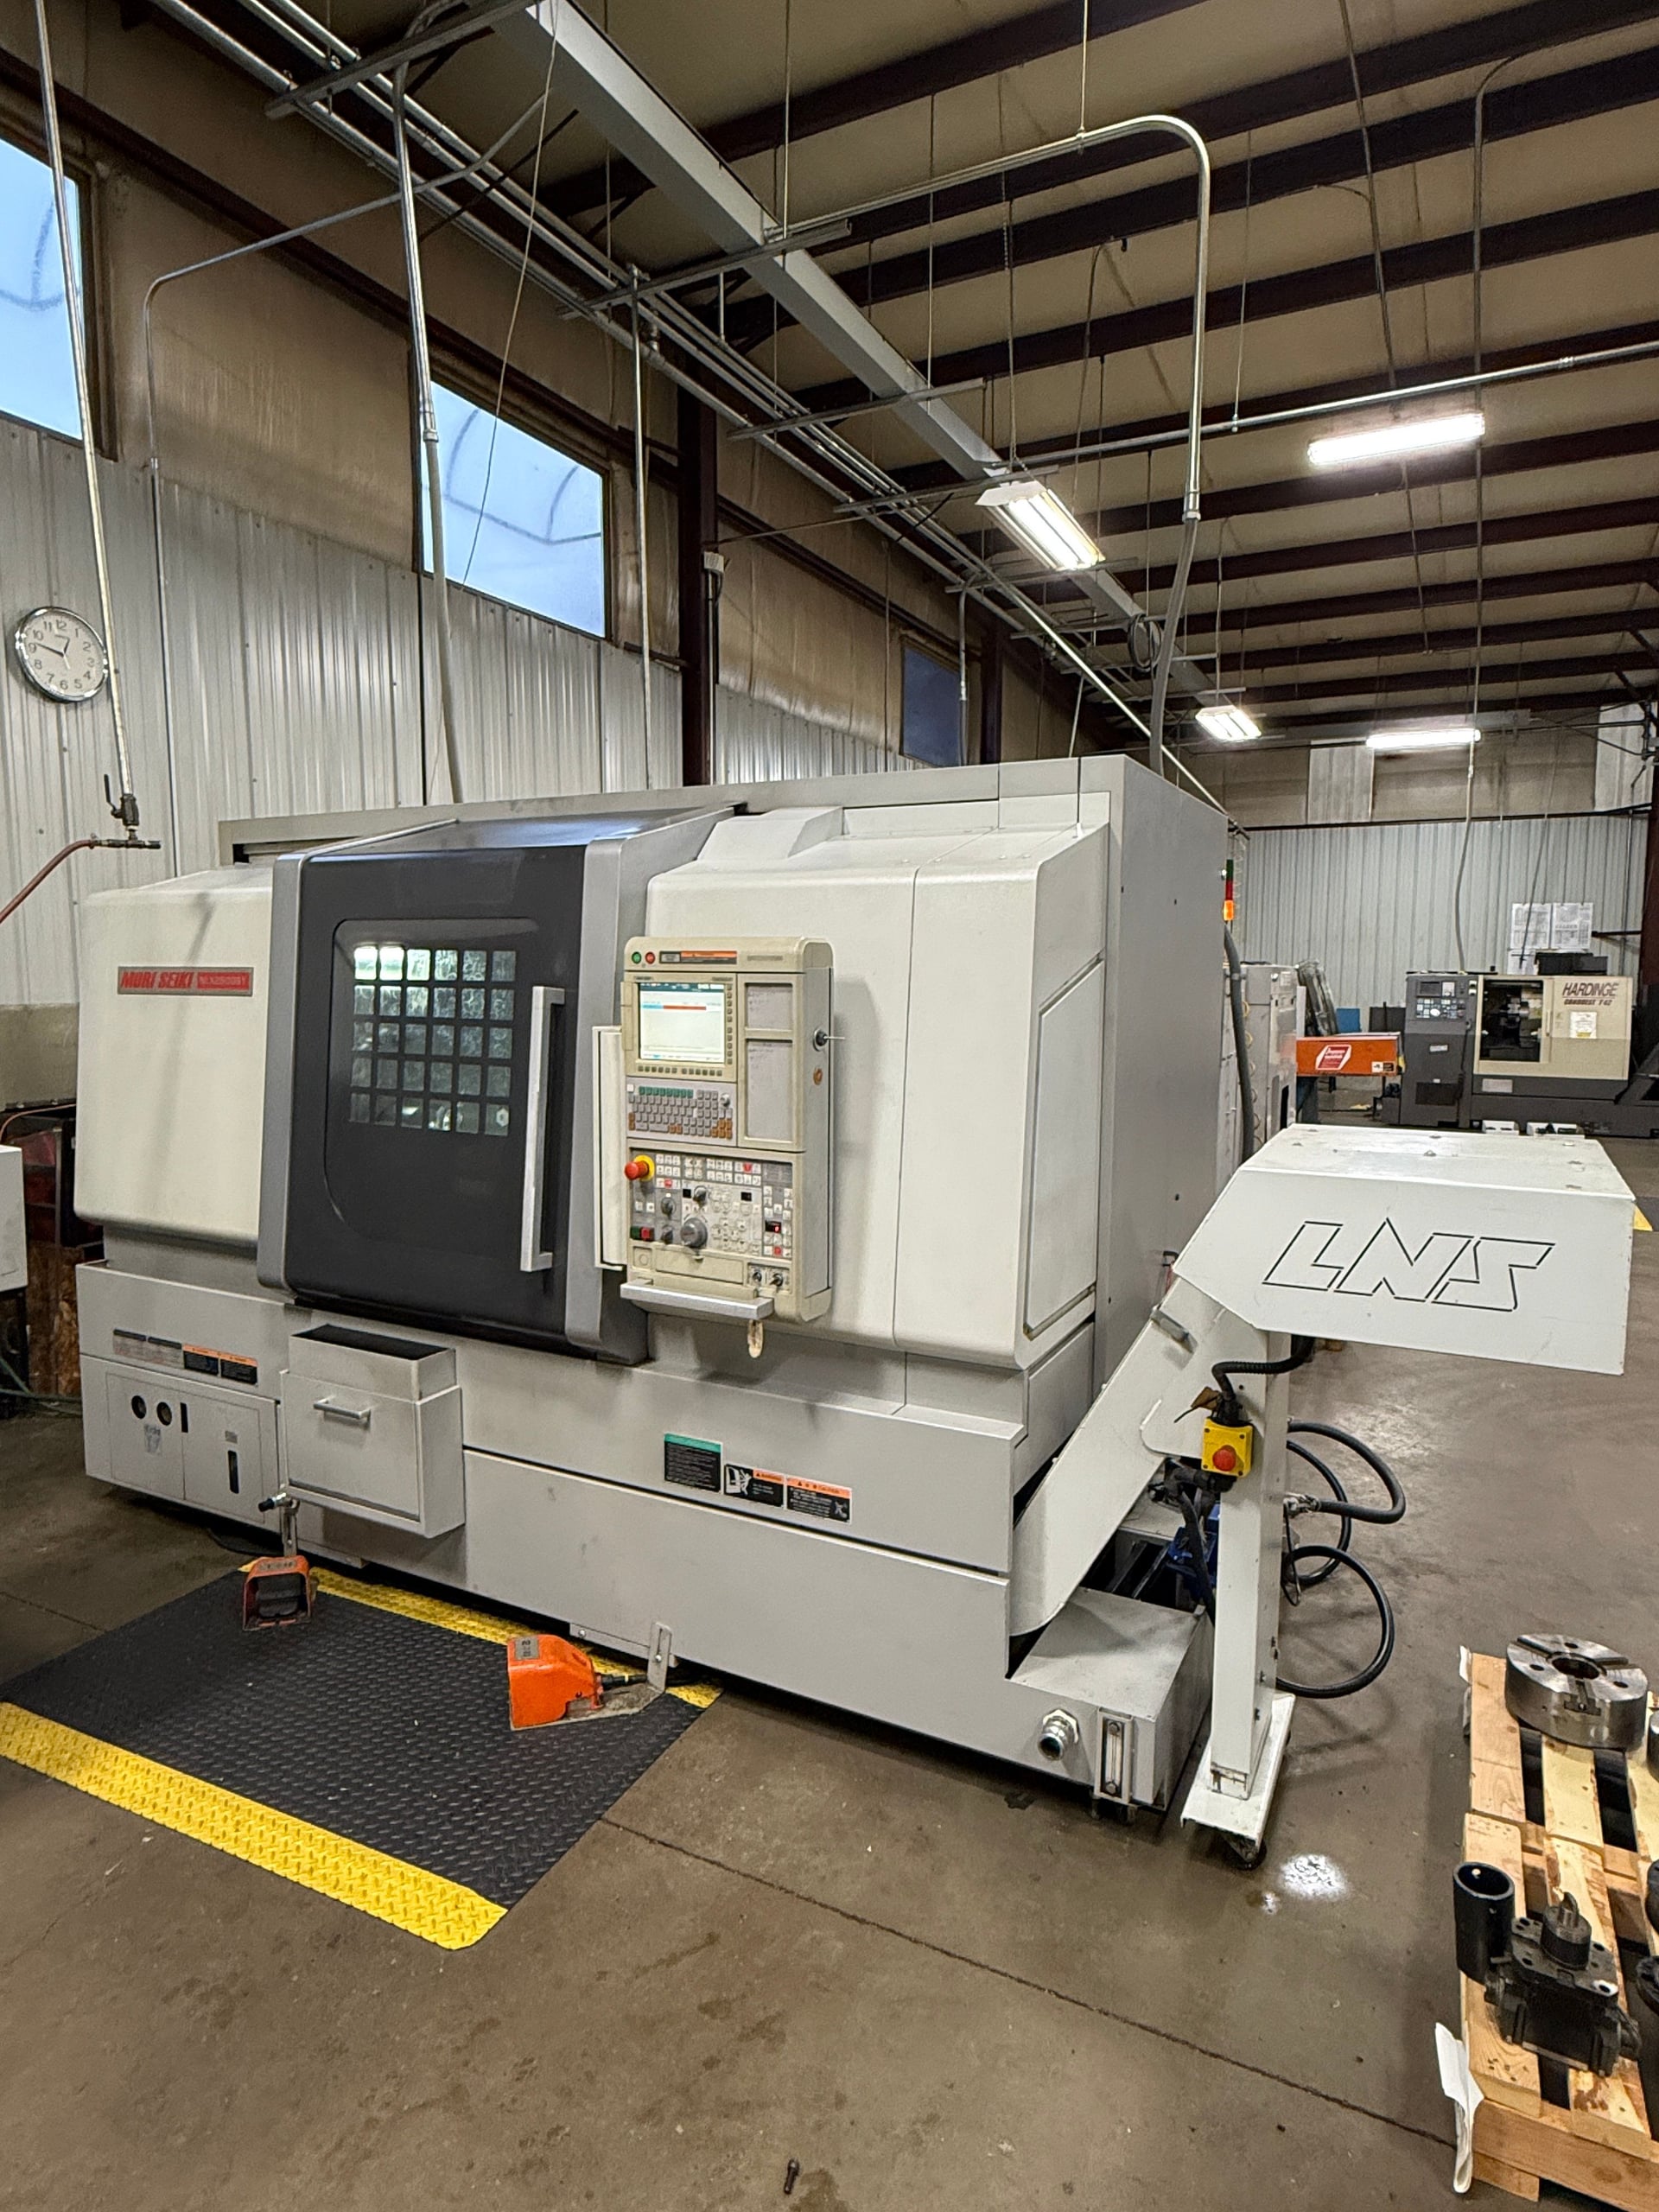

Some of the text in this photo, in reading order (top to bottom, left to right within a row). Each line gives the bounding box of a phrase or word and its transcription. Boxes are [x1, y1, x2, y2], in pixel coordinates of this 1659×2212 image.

[44, 620, 52, 632] 11
[55, 620, 67, 630] 12
[33, 630, 44, 640] 10
[74, 628, 79, 638] 1
[29, 643, 37, 653] 9
[82, 641, 92, 652] 2
[34, 659, 42, 670] 8
[86, 658, 95, 668] 3
[47, 673, 55, 683] 7
[83, 671, 92, 680] 4
[60, 680, 68, 690] 6
[73, 679, 82, 689] 5
[158, 972, 194, 988] SEIKI
[1562, 982, 1619, 996] HARDINGE
[1262, 1217, 1556, 1312] LNS
